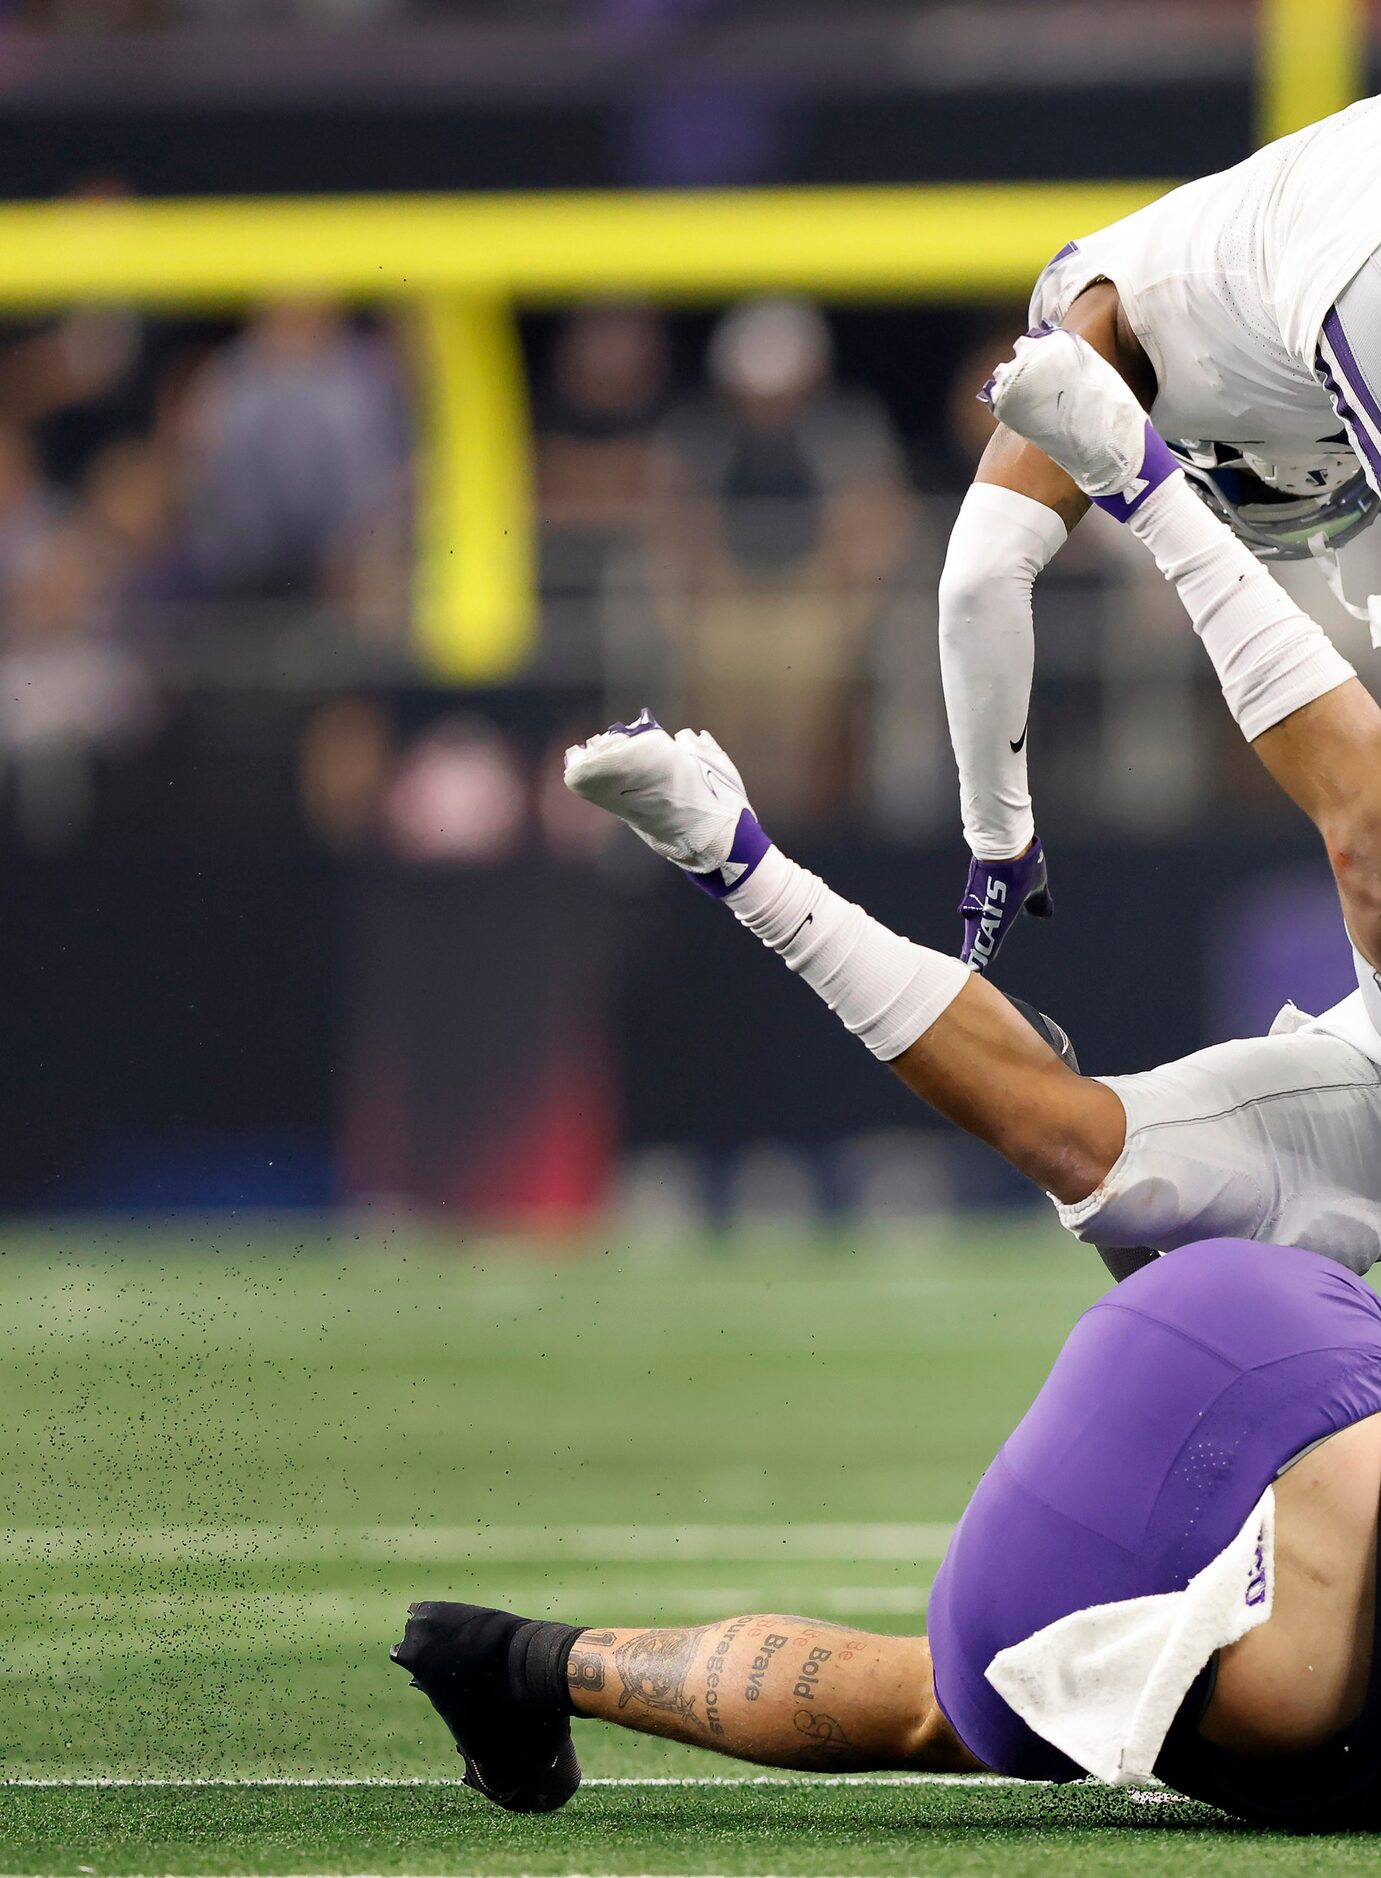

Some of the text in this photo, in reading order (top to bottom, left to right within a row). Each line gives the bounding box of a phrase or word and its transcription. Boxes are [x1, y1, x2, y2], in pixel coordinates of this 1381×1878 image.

[567, 1631, 617, 1692] 18
[705, 1616, 753, 1736] ourageous
[745, 1634, 789, 1702] Brave
[793, 1646, 832, 1700] Bold
